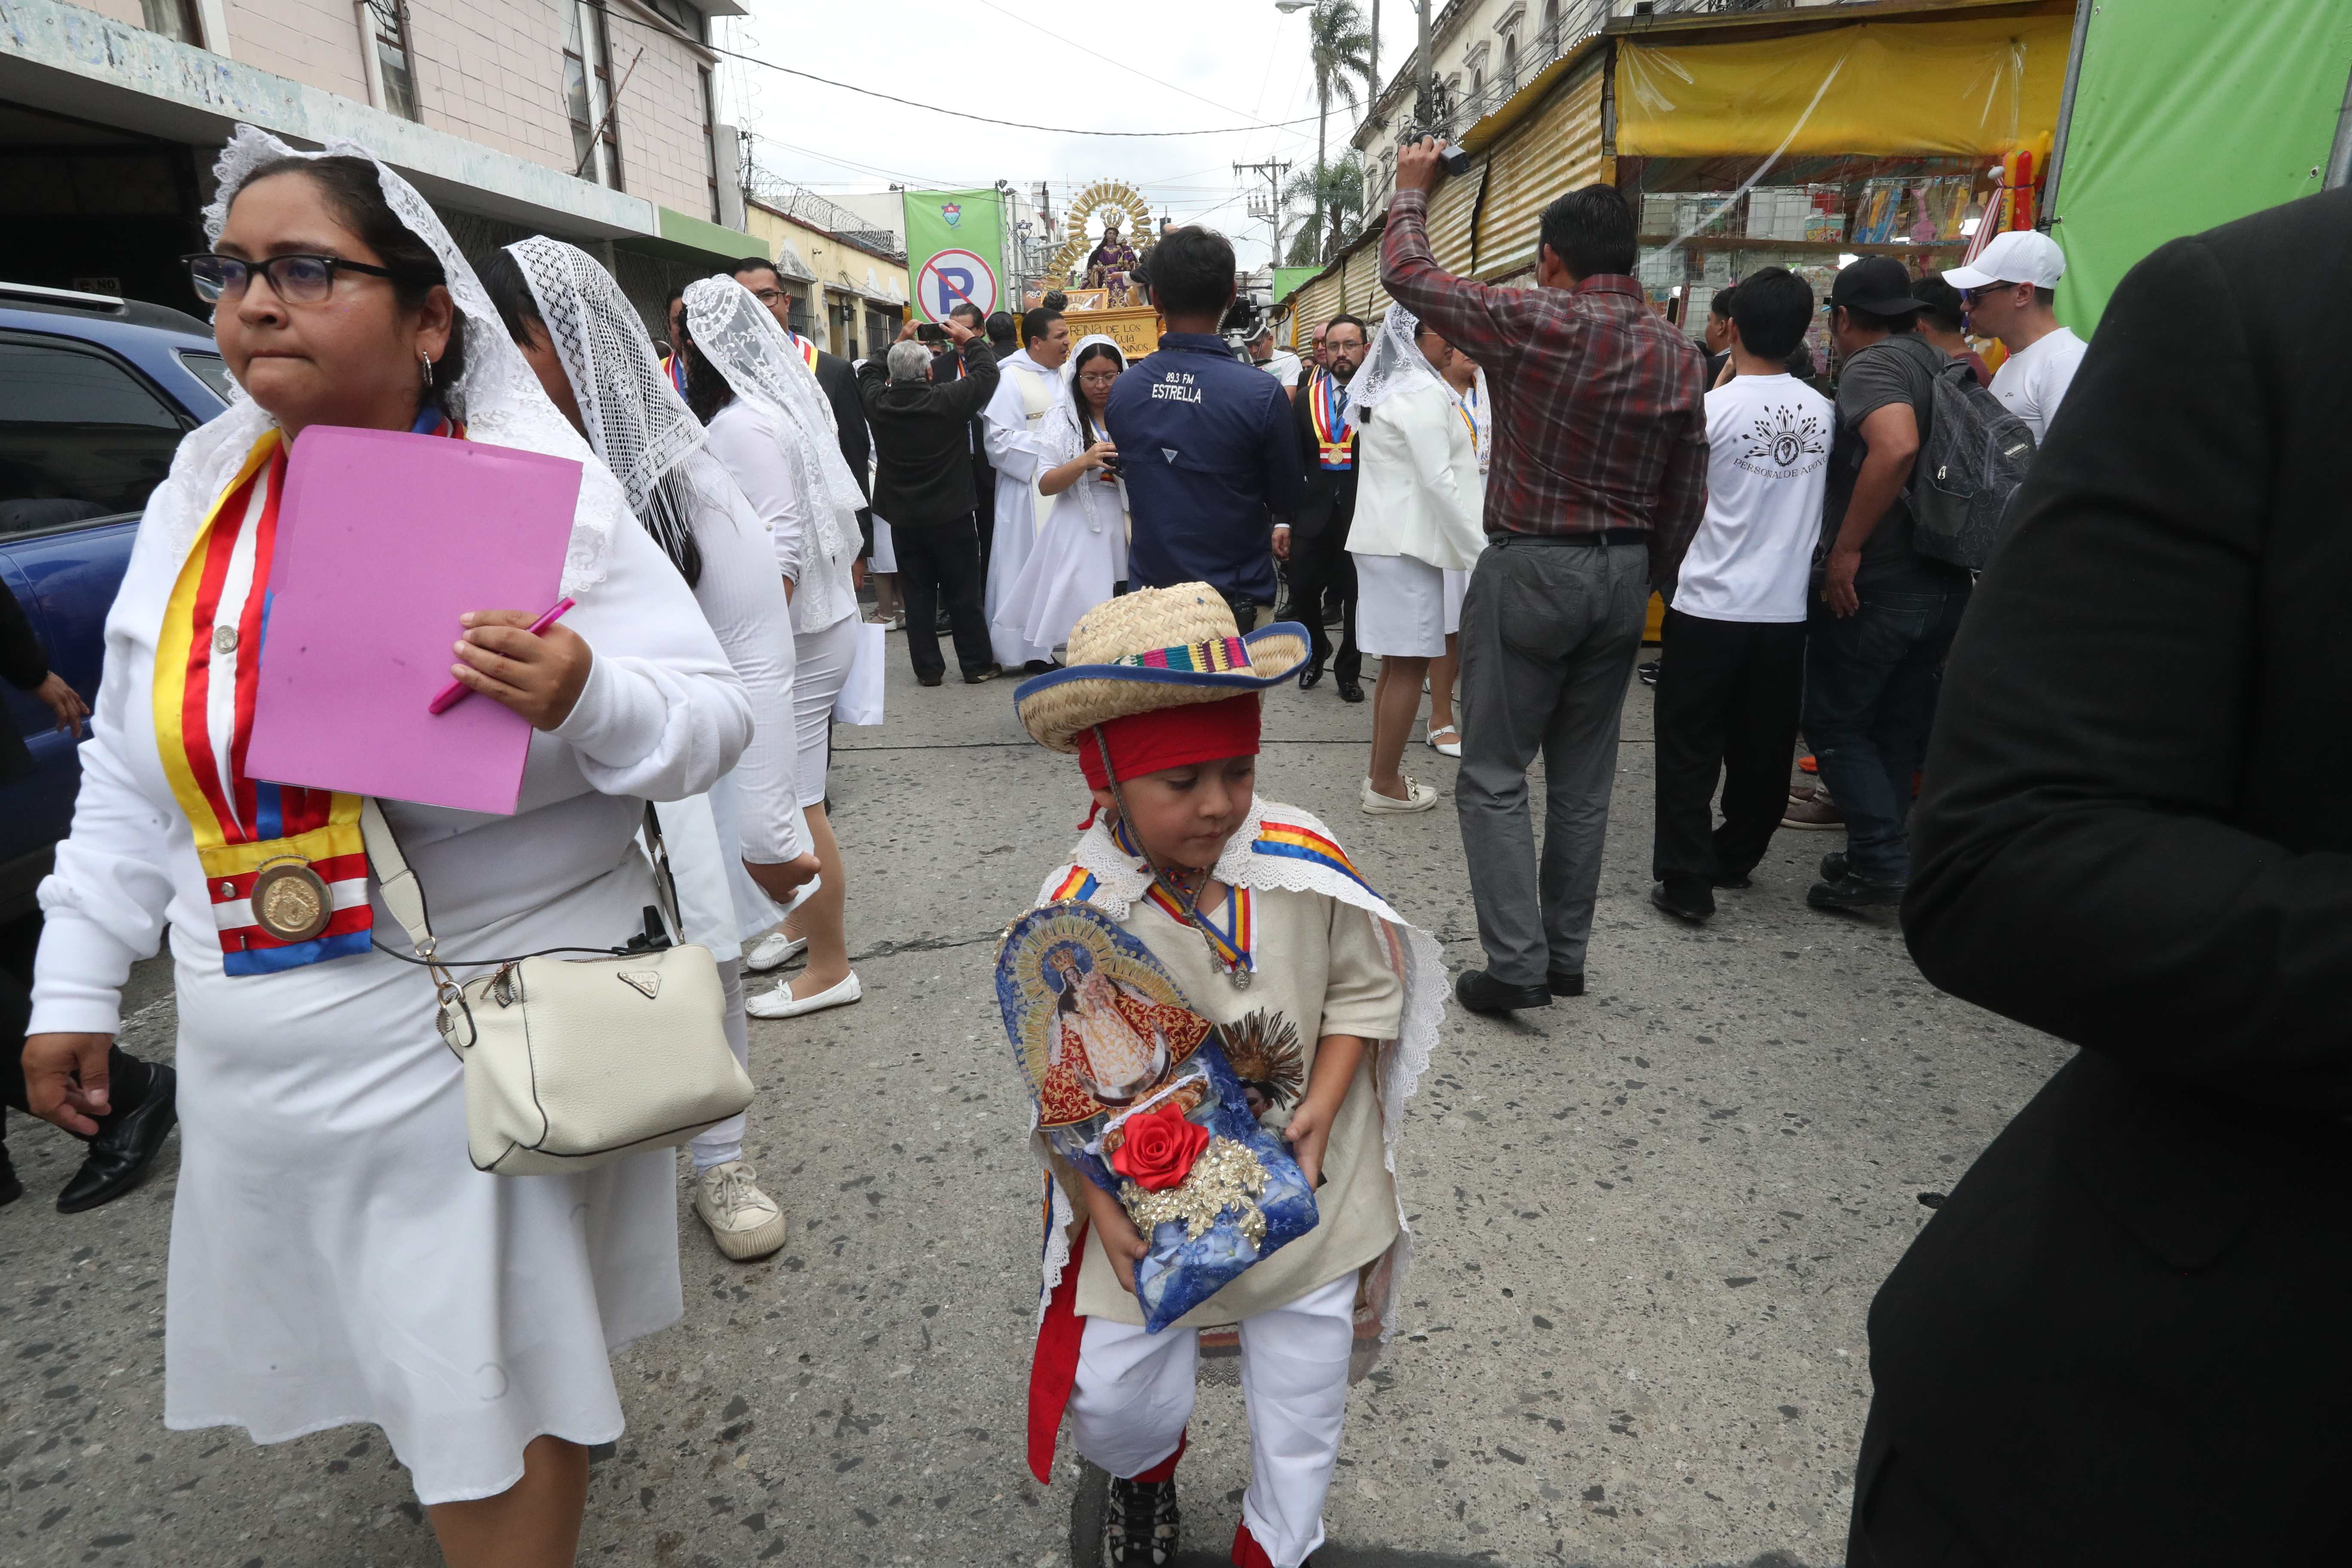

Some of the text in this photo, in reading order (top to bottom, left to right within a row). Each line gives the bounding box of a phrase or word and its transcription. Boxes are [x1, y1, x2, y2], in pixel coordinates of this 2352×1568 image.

[938, 268, 974, 315] P
[1026, 290, 1041, 299] 250
[1106, 325, 1119, 334] DE
[1124, 324, 1140, 332] LOS
[1166, 372, 1194, 385] 89.3 FM
[1152, 383, 1201, 404] ESTRELLA
[1733, 454, 1828, 479] PERSONAL DE APOYO
